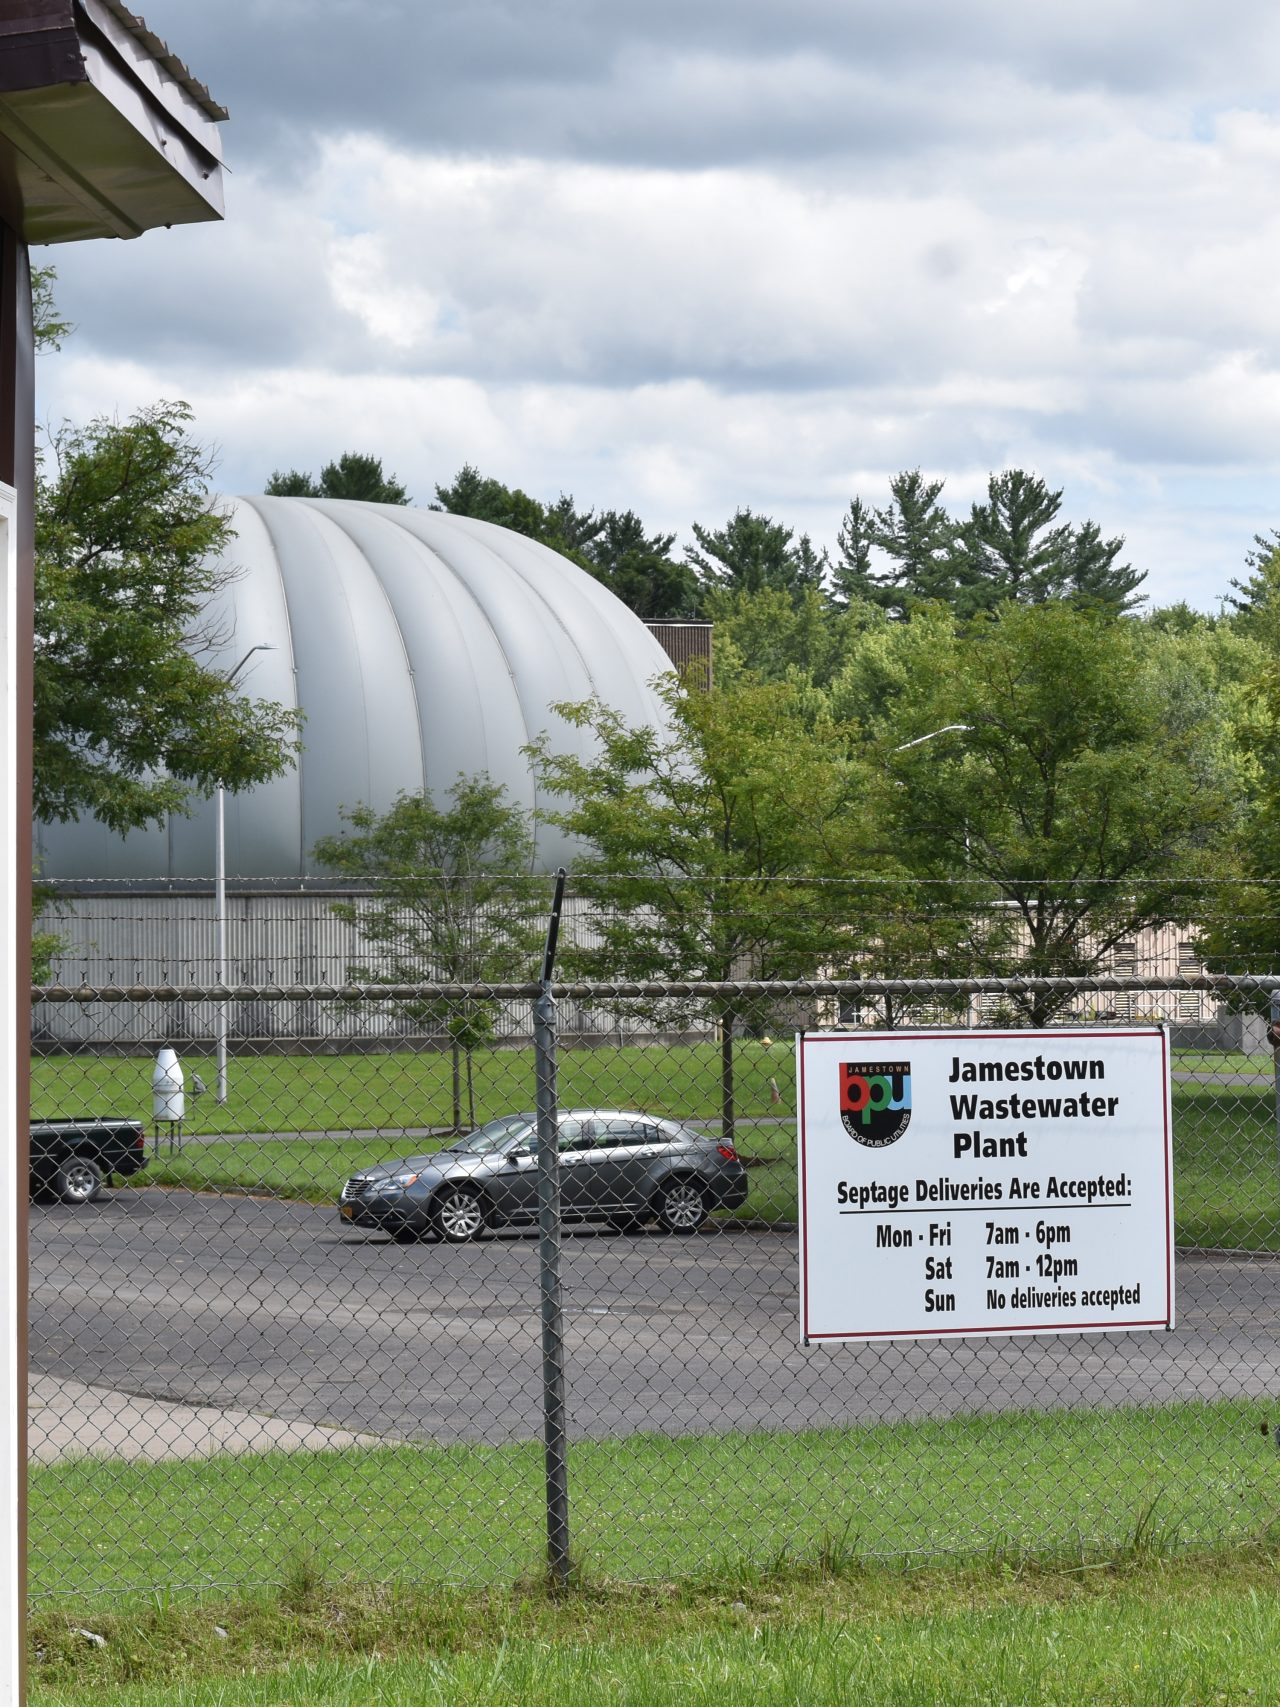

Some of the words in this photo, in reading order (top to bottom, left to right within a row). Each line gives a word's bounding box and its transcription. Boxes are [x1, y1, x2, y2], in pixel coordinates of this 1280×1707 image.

[948, 1055, 1105, 1083] Jamestown
[839, 1062, 912, 1125] bpu
[949, 1092, 1119, 1121] Wastewater
[842, 1115, 858, 1138] BOARD
[867, 1137, 891, 1147] PUBLIC
[890, 1113, 909, 1140] UTILITIES
[953, 1131, 1028, 1159] Plant
[837, 1181, 909, 1210] Septage
[915, 1177, 1003, 1202] Deliveries
[1008, 1177, 1041, 1200] Are
[1046, 1173, 1132, 1205] Accepted:
[876, 1224, 913, 1248] Mon
[929, 1222, 952, 1247] Fri
[985, 1222, 1020, 1245] 7am
[1035, 1220, 1071, 1250] 6pm
[925, 1256, 953, 1281] Sat
[985, 1255, 1020, 1279] 7am
[1035, 1254, 1078, 1284] 12pm
[924, 1288, 956, 1313] Sun
[986, 1289, 1006, 1310] No
[1010, 1285, 1077, 1309] deliveries
[1081, 1282, 1141, 1311] accepted
